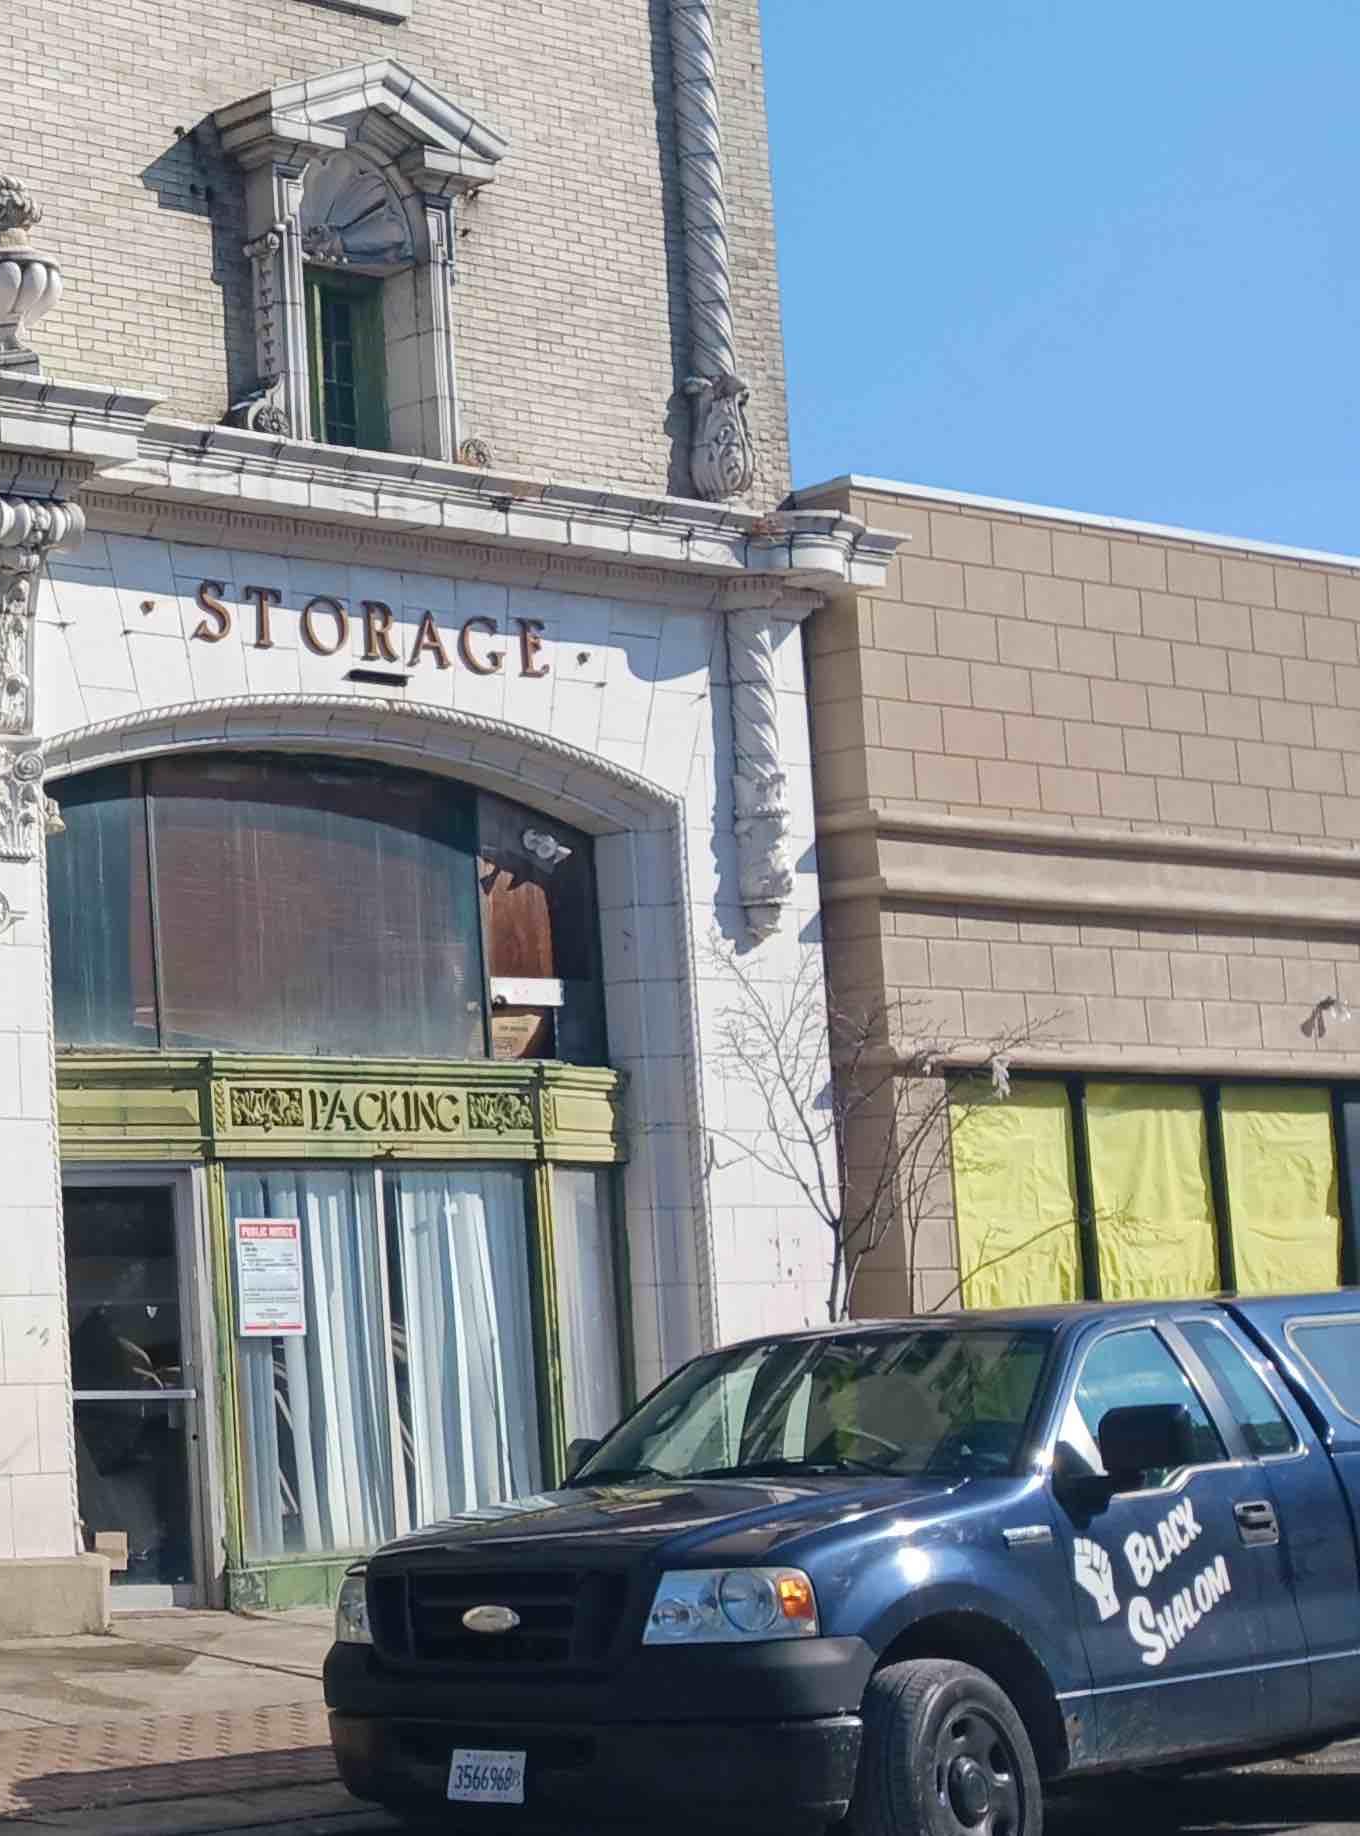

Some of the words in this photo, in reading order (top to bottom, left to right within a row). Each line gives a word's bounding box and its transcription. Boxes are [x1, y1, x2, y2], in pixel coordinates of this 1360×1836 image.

[189, 578, 551, 679] STORAGE
[308, 1088, 461, 1132] PACKING
[1124, 1496, 1203, 1588] BLACK
[1128, 1555, 1232, 1666] SHALOM
